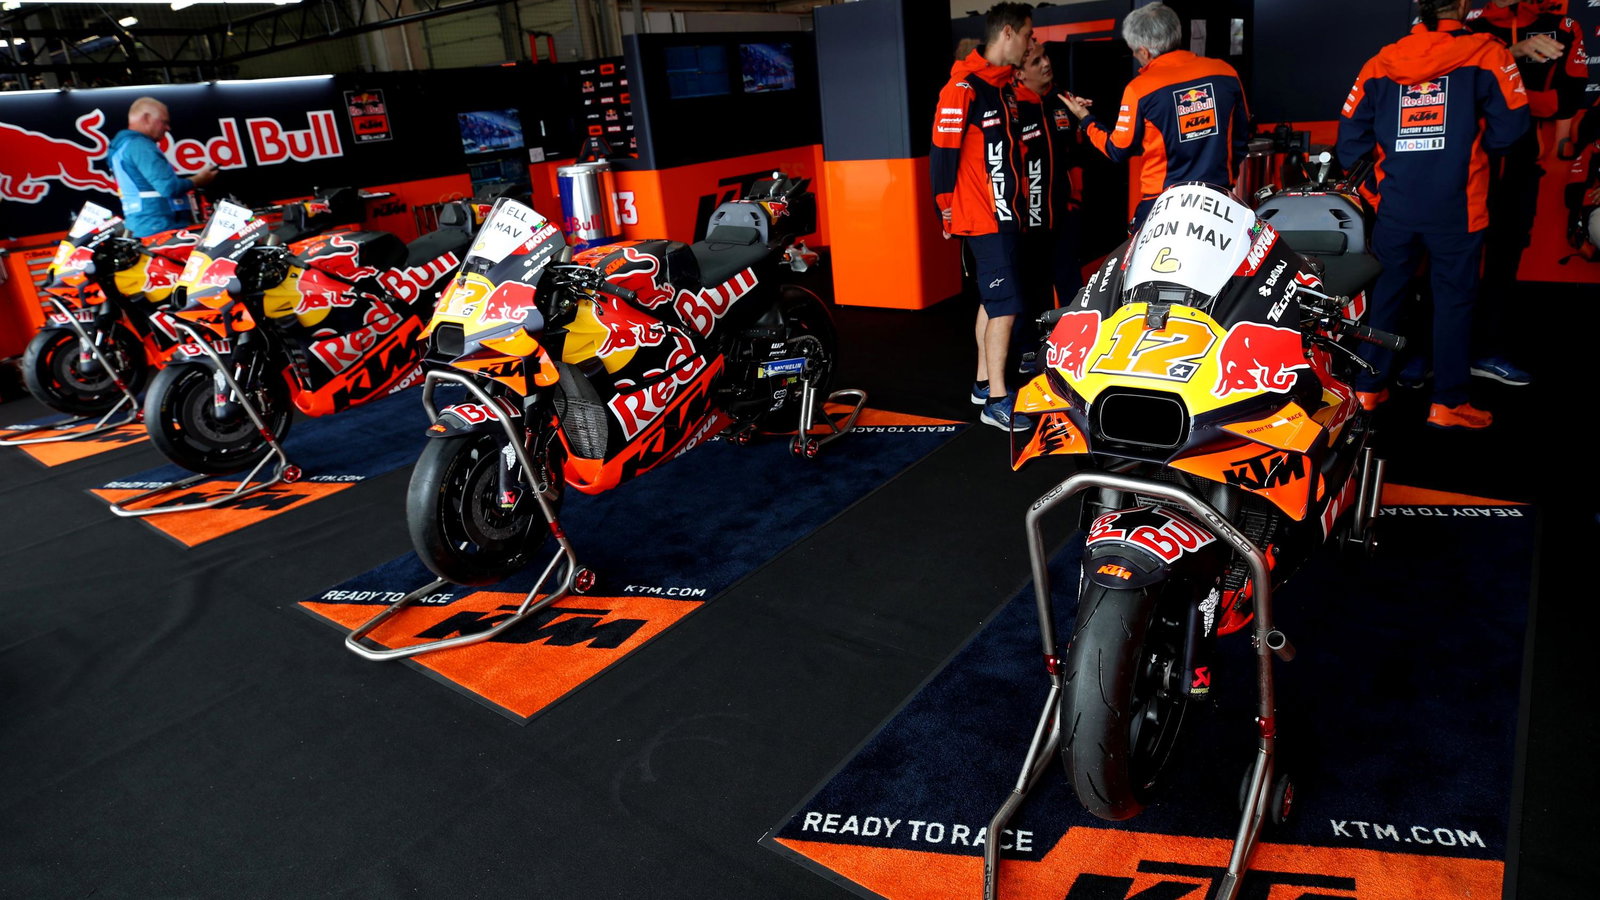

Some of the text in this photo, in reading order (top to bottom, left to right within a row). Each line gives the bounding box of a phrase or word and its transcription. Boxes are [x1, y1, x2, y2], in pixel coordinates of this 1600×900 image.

[1178, 98, 1214, 116] Red Bull
[1402, 92, 1444, 107] Red Bull
[1185, 116, 1211, 128] KTM
[1408, 111, 1438, 122] KTM
[1423, 125, 1443, 133] RACING
[245, 110, 343, 166] Bull
[1397, 140, 1429, 150] Mobil
[1148, 193, 1234, 224] GET WELL
[239, 218, 266, 238] MOTUL
[496, 222, 523, 239] MAV
[524, 224, 557, 251] MOTUL
[1139, 221, 1179, 250] SOON
[1186, 221, 1232, 251] MAV
[1249, 226, 1277, 271] MOTUL
[375, 251, 460, 306] Bull
[673, 267, 759, 339] Bull
[308, 293, 403, 376] Red
[1088, 312, 1218, 383] 12
[333, 325, 426, 414] KTM
[388, 364, 424, 395] MOTU
[774, 363, 801, 371] MICHELIN
[607, 328, 708, 442] Red
[621, 382, 715, 478] KTM
[674, 414, 718, 459] MOTUL
[1246, 426, 1264, 434] READY
[1287, 412, 1303, 422] RACE
[1222, 452, 1306, 491] KTM
[1379, 507, 1524, 517] READY TO RA
[1126, 507, 1218, 564] Bull
[1097, 563, 1133, 580] KTM
[321, 590, 454, 604] READY TO ACE
[624, 584, 706, 597] KTM.COM
[413, 604, 649, 650] KTM
[802, 811, 902, 838] READY
[907, 820, 945, 843] TO
[1330, 819, 1487, 848] KTM.COM
